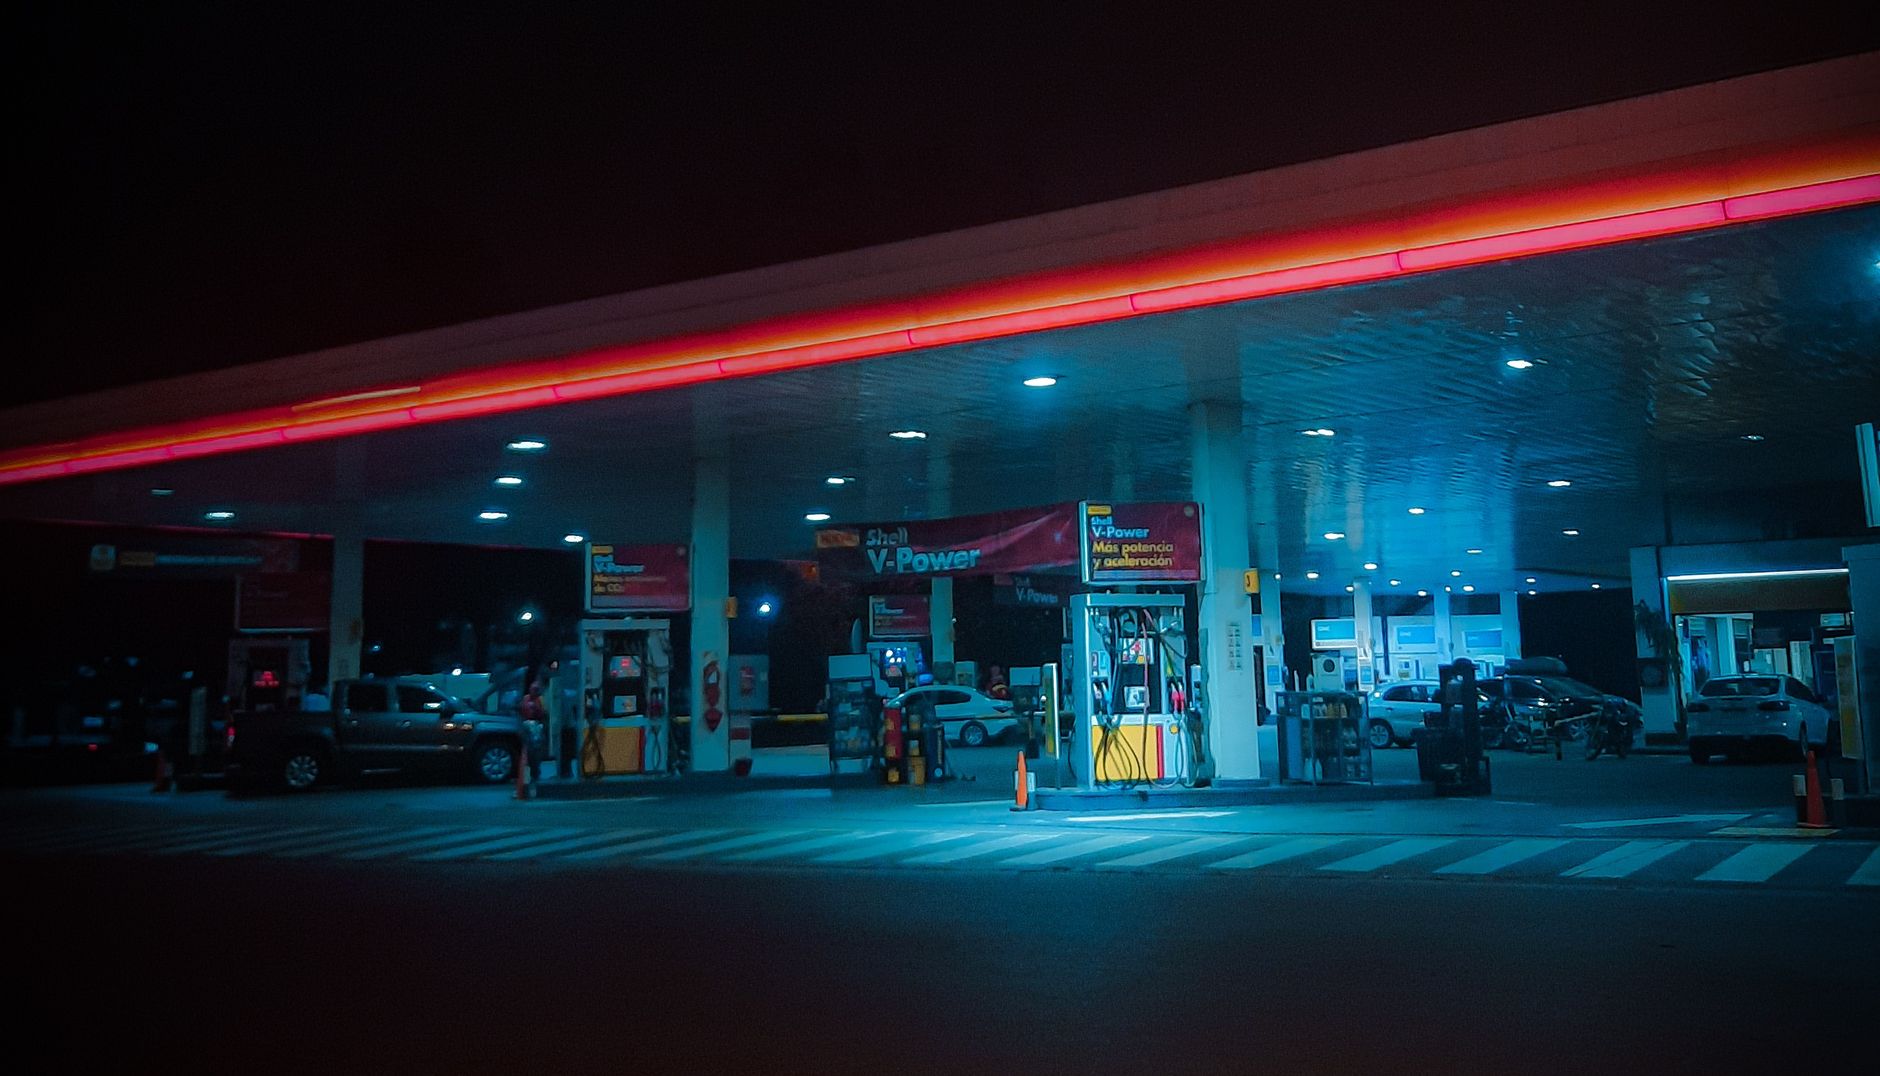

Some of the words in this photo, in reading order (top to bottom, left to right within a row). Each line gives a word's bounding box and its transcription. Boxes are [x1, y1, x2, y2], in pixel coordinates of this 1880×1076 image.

[866, 528, 909, 547] Shell
[1092, 527, 1150, 539] V-Power
[1093, 540, 1119, 553] Más
[1121, 540, 1174, 556] potencia
[867, 547, 982, 574] V-Power
[1093, 558, 1101, 570] y
[1104, 554, 1173, 568] aceleración
